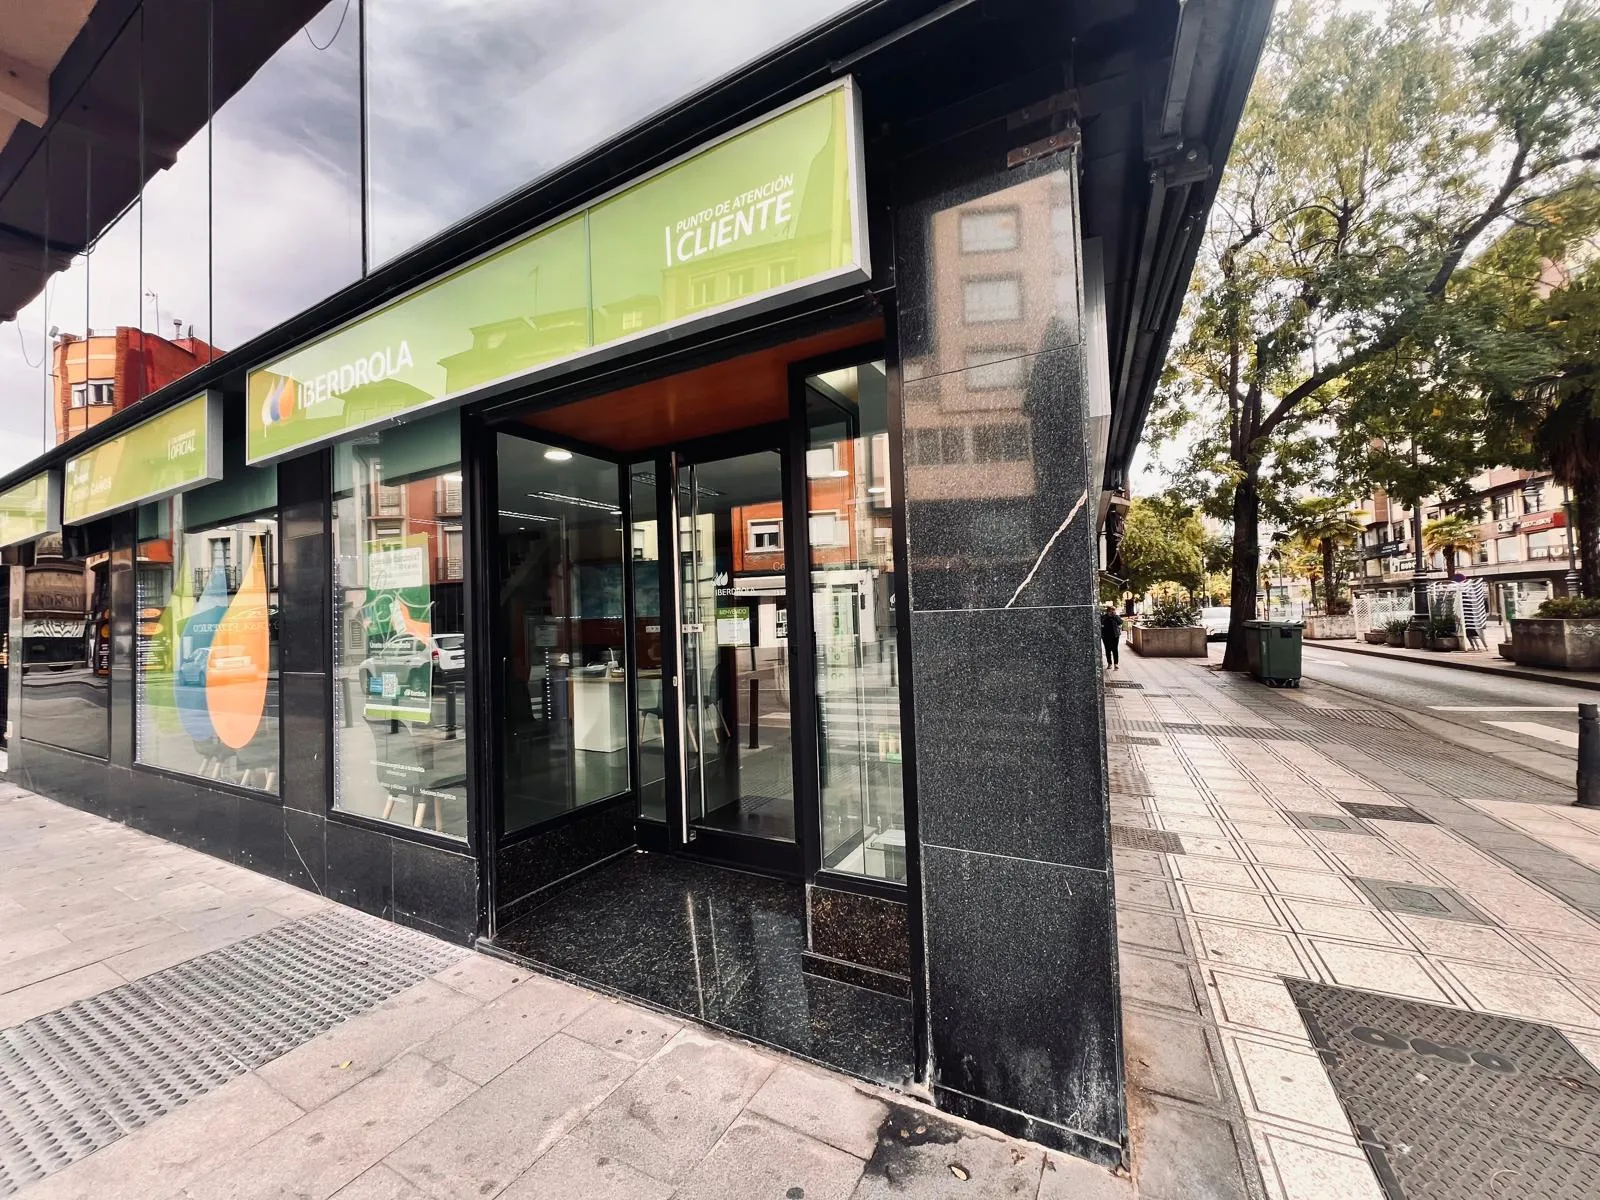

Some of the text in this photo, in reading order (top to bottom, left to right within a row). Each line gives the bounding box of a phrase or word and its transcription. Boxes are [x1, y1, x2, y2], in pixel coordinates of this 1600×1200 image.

[676, 173, 794, 233] PUNTO DE ATENCIÓN
[676, 190, 795, 262] CLIENTE
[297, 340, 414, 410] IBERDROLA
